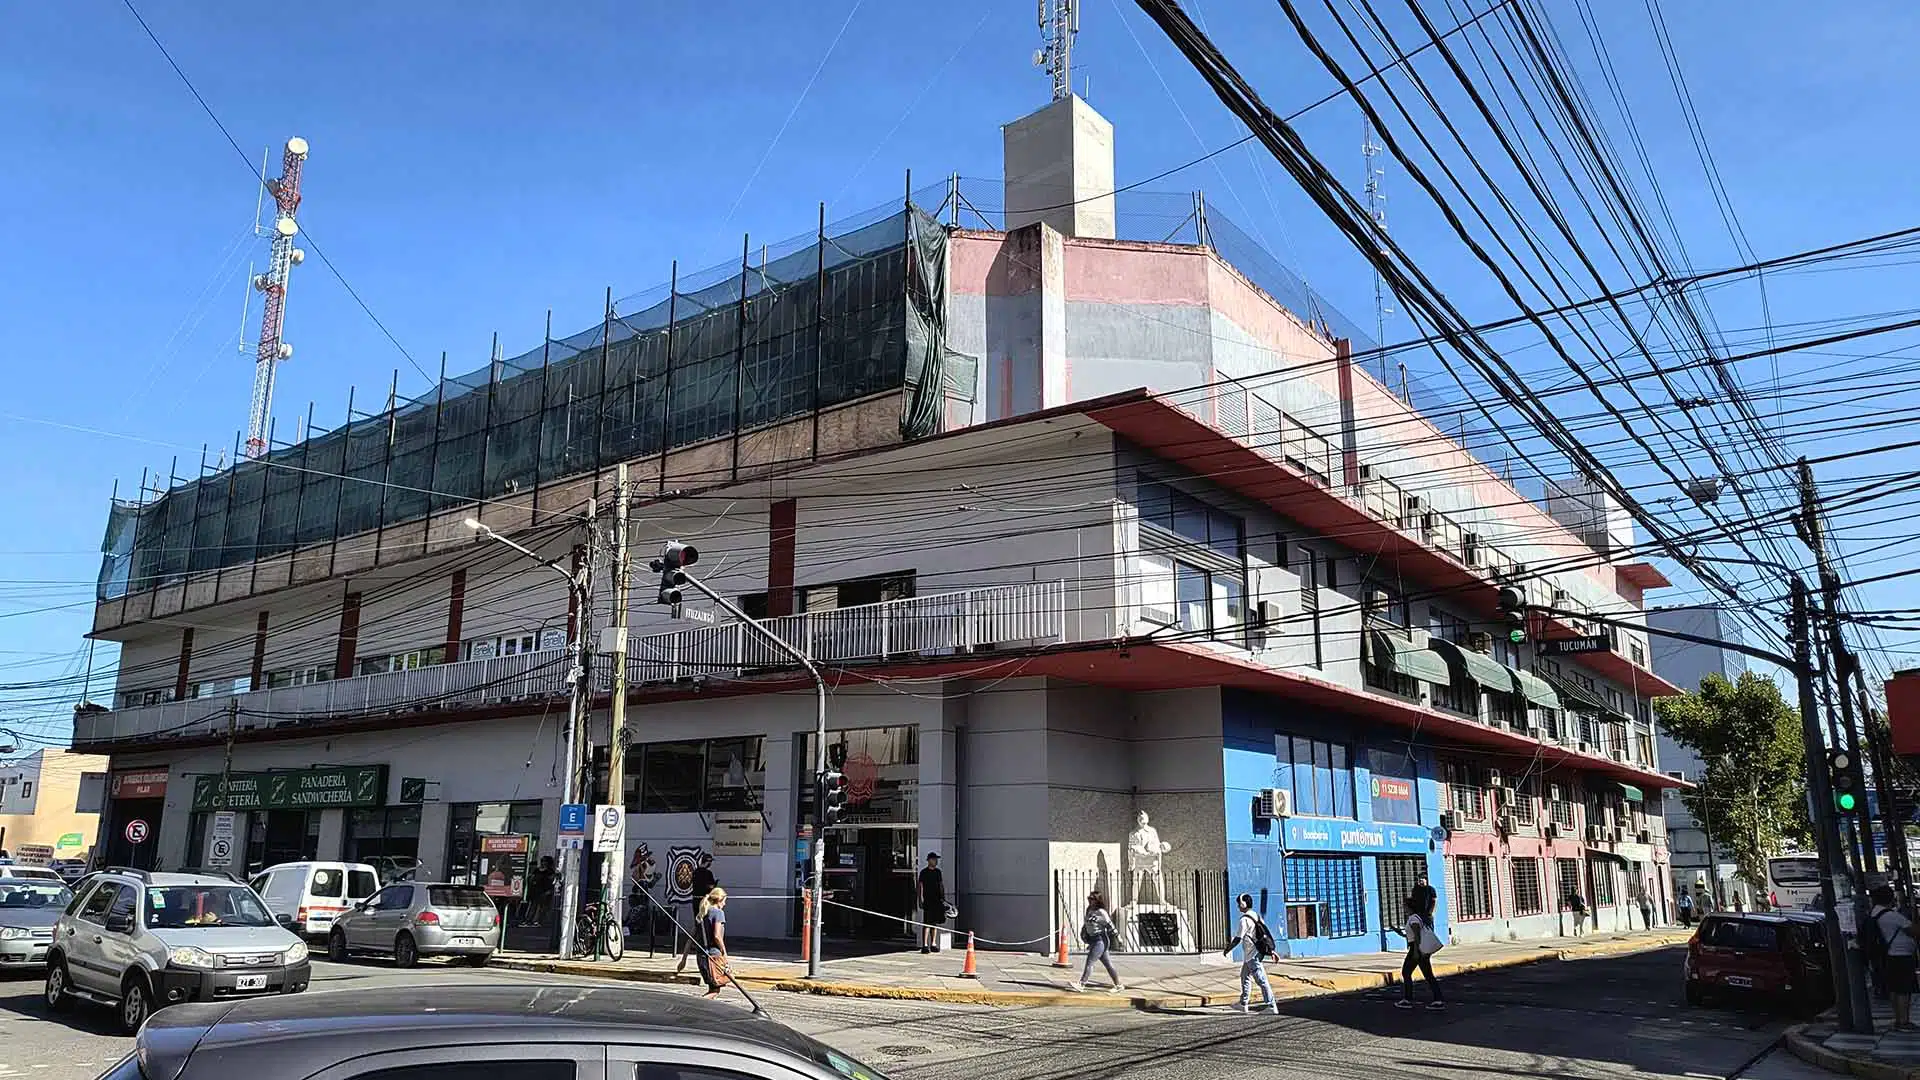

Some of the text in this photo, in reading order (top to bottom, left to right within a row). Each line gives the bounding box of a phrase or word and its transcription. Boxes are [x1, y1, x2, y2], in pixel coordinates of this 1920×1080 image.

[1559, 637, 1598, 652] TUCUMÁN
[218, 778, 258, 793] CNFITERÍA
[300, 772, 347, 788] PANADERÍA
[291, 787, 353, 804] SANDWICHERÍA
[569, 812, 577, 823] E
[606, 810, 617, 825] E
